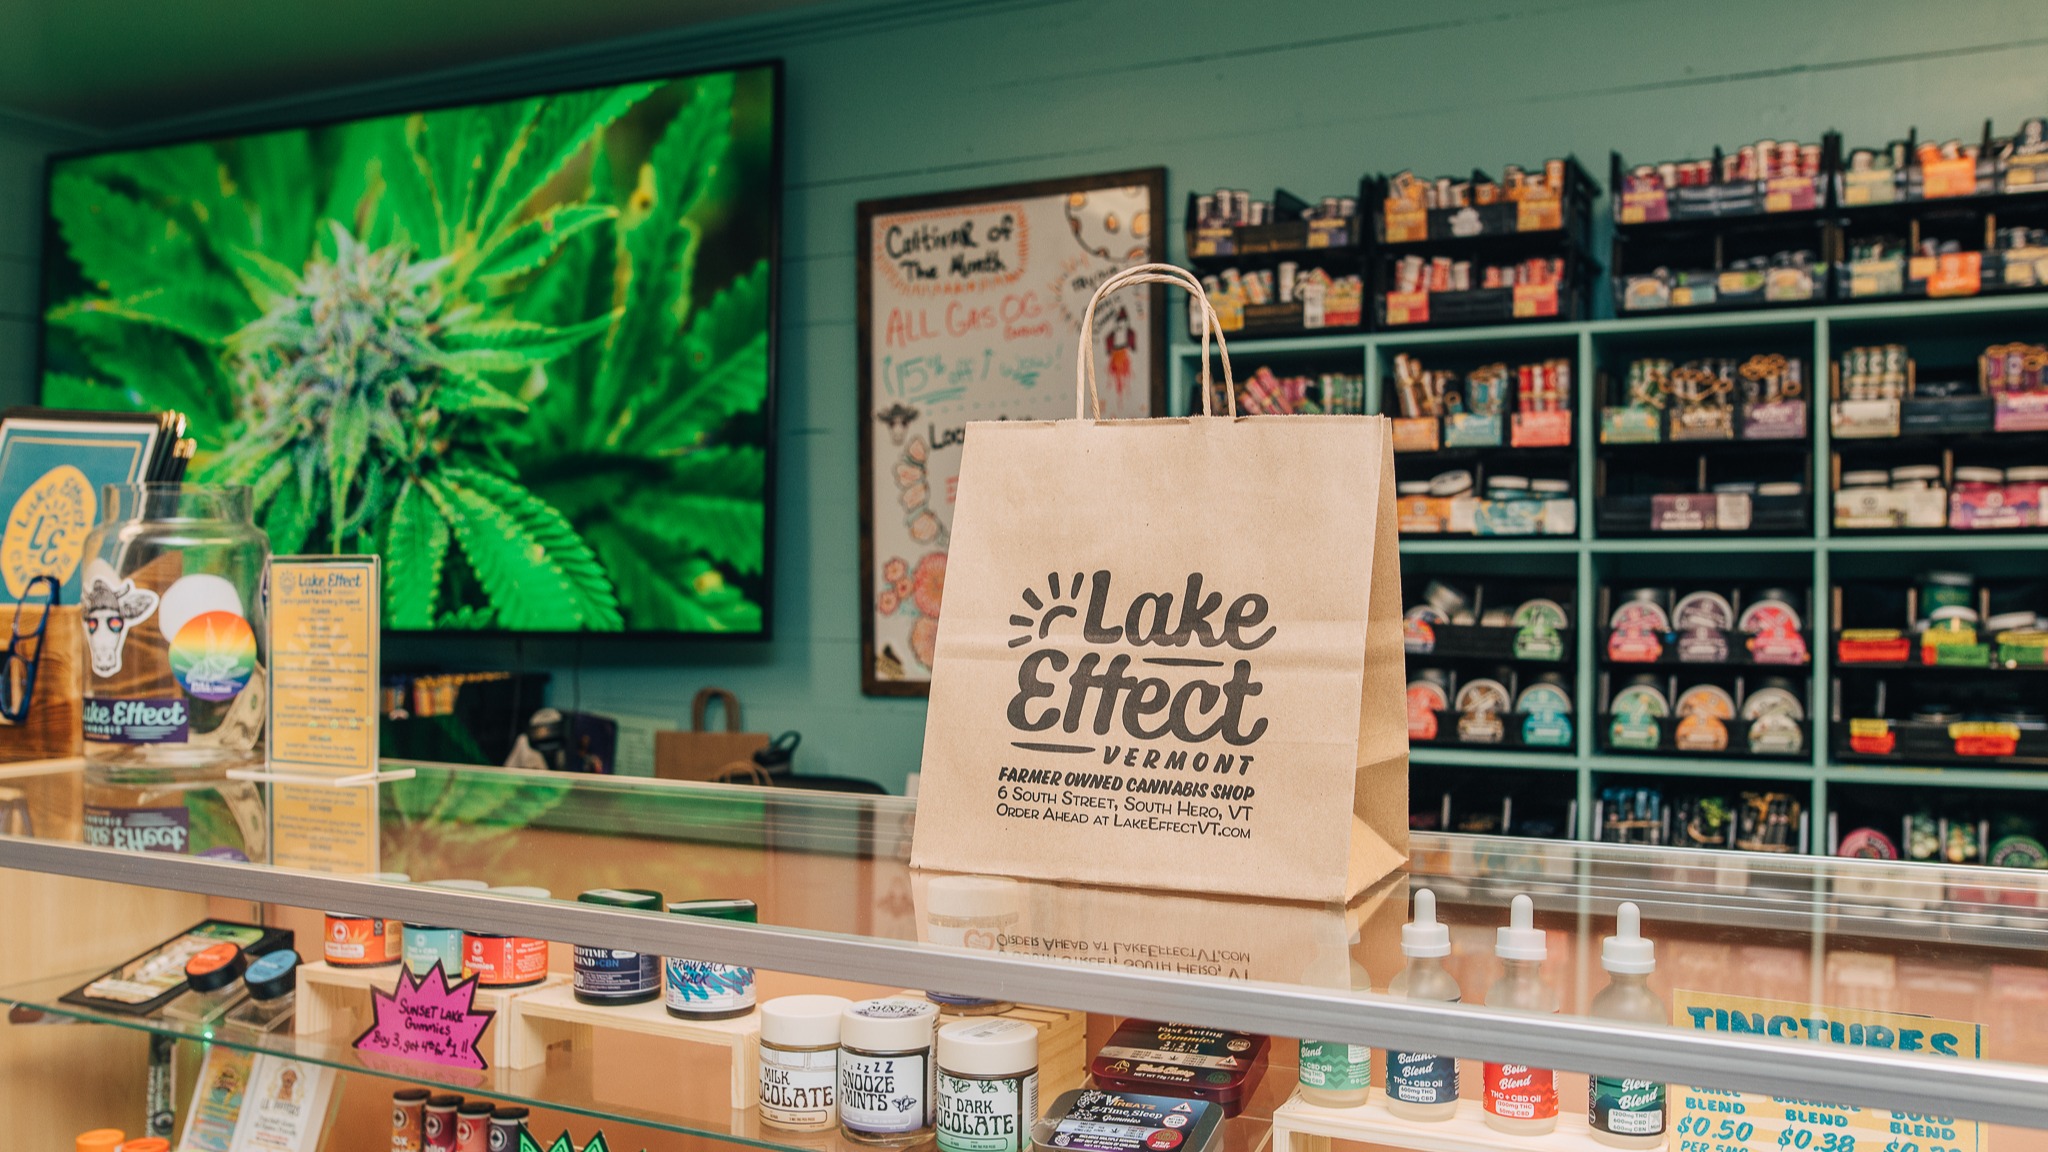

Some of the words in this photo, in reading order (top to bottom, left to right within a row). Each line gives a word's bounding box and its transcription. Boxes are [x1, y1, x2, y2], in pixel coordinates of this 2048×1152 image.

[900, 260, 937, 281] The
[886, 307, 939, 347] ALL
[298, 573, 325, 588] Lake
[328, 572, 362, 588] Effect
[1083, 570, 1277, 651] Lake
[1007, 649, 1269, 746] Effect
[84, 701, 111, 724] ake
[112, 701, 187, 726] Effect
[1103, 745, 1254, 776] VERMONT
[998, 766, 1062, 786] FARMER
[1064, 771, 1123, 791] OWNED
[1126, 777, 1209, 798] CANNABIS
[1211, 784, 1255, 801] SHOP
[997, 785, 1008, 800] 6
[1228, 804, 1253, 821] VT
[440, 1008, 465, 1023] LAKE
[405, 1017, 451, 1036] Gummies
[373, 1030, 391, 1049] Buy
[764, 1066, 790, 1086] MILK
[1402, 1062, 1434, 1077] Blend
[842, 1068, 895, 1094] SNOOZE
[1393, 1076, 1407, 1085] THC
[1432, 1080, 1443, 1088] Oil
[1499, 1074, 1532, 1090] Blend
[760, 1079, 833, 1109] OCOLATE
[845, 1088, 888, 1112] MINTS
[1491, 1089, 1505, 1099] THC
[1511, 1094, 1529, 1102] CBD
[1530, 1095, 1541, 1103] Oil
[1618, 1086, 1659, 1109] Blend
[956, 1097, 994, 1115] DARK
[1131, 1110, 1163, 1120] Sleep
[1686, 1097, 1746, 1115] BLEND
[938, 1106, 1014, 1136] OCOLATE
[1677, 1112, 1754, 1142] $0.50
[1786, 1109, 1848, 1128] BLEND
[1777, 1124, 1856, 1152] $0.38
[1889, 1121, 1956, 1141] BLEND
[1680, 1140, 1710, 1152] PER
